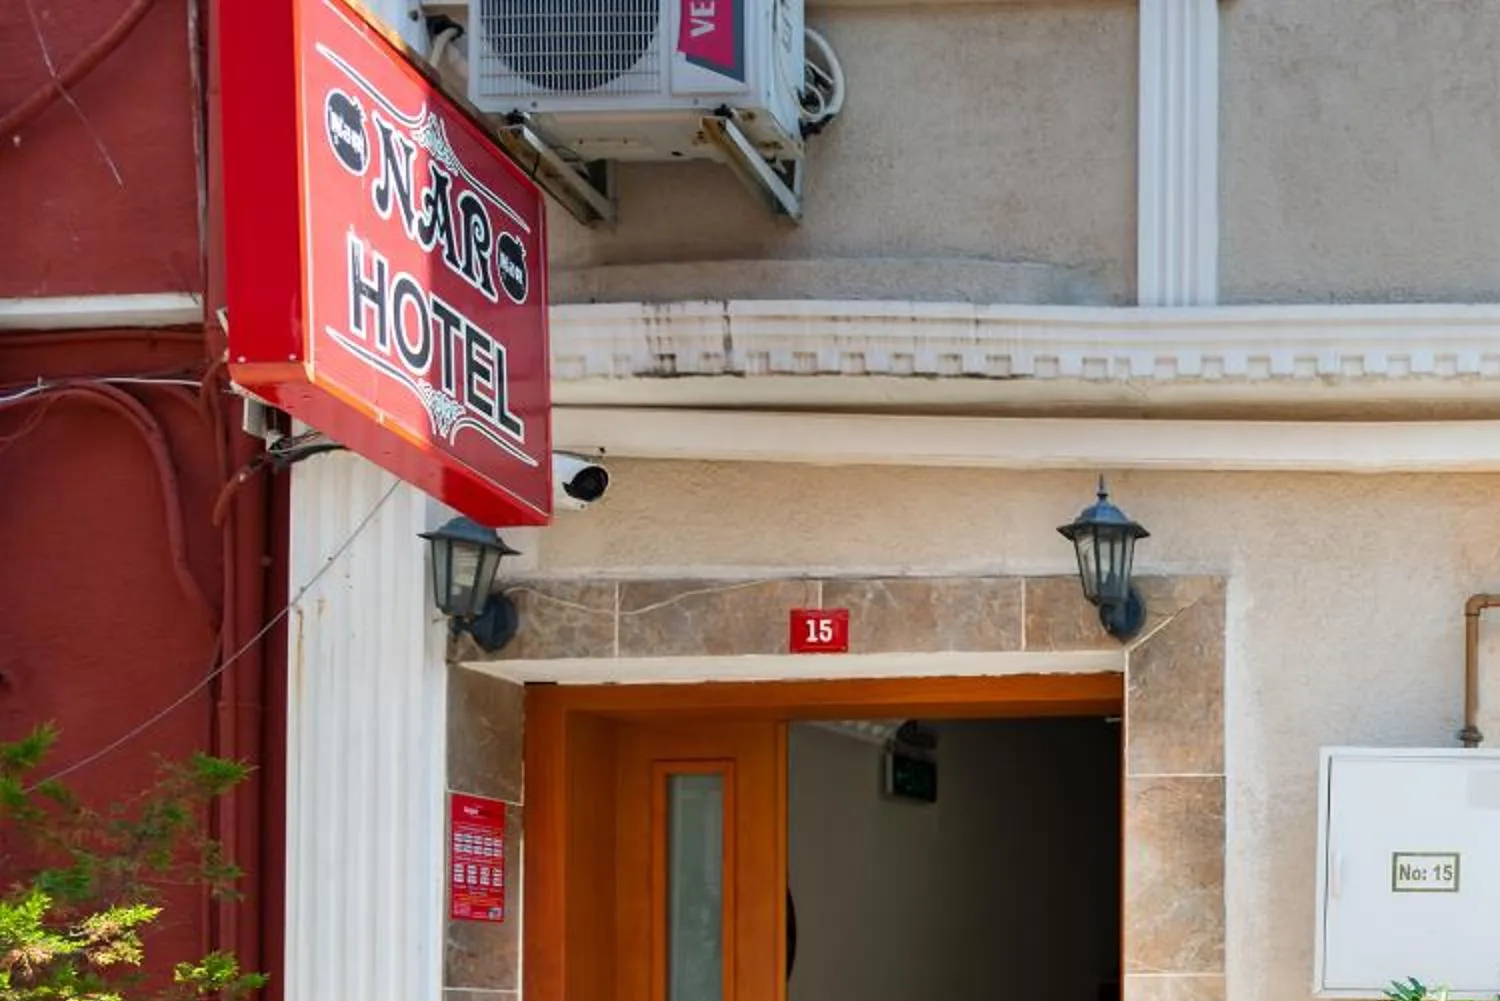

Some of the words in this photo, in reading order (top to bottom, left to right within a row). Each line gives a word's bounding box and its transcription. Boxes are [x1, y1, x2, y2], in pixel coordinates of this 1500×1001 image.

[372, 111, 498, 303] NAR
[347, 230, 524, 443] HOTEL
[806, 619, 833, 643] 15
[1399, 863, 1428, 881] No:
[1432, 863, 1453, 881] 15
